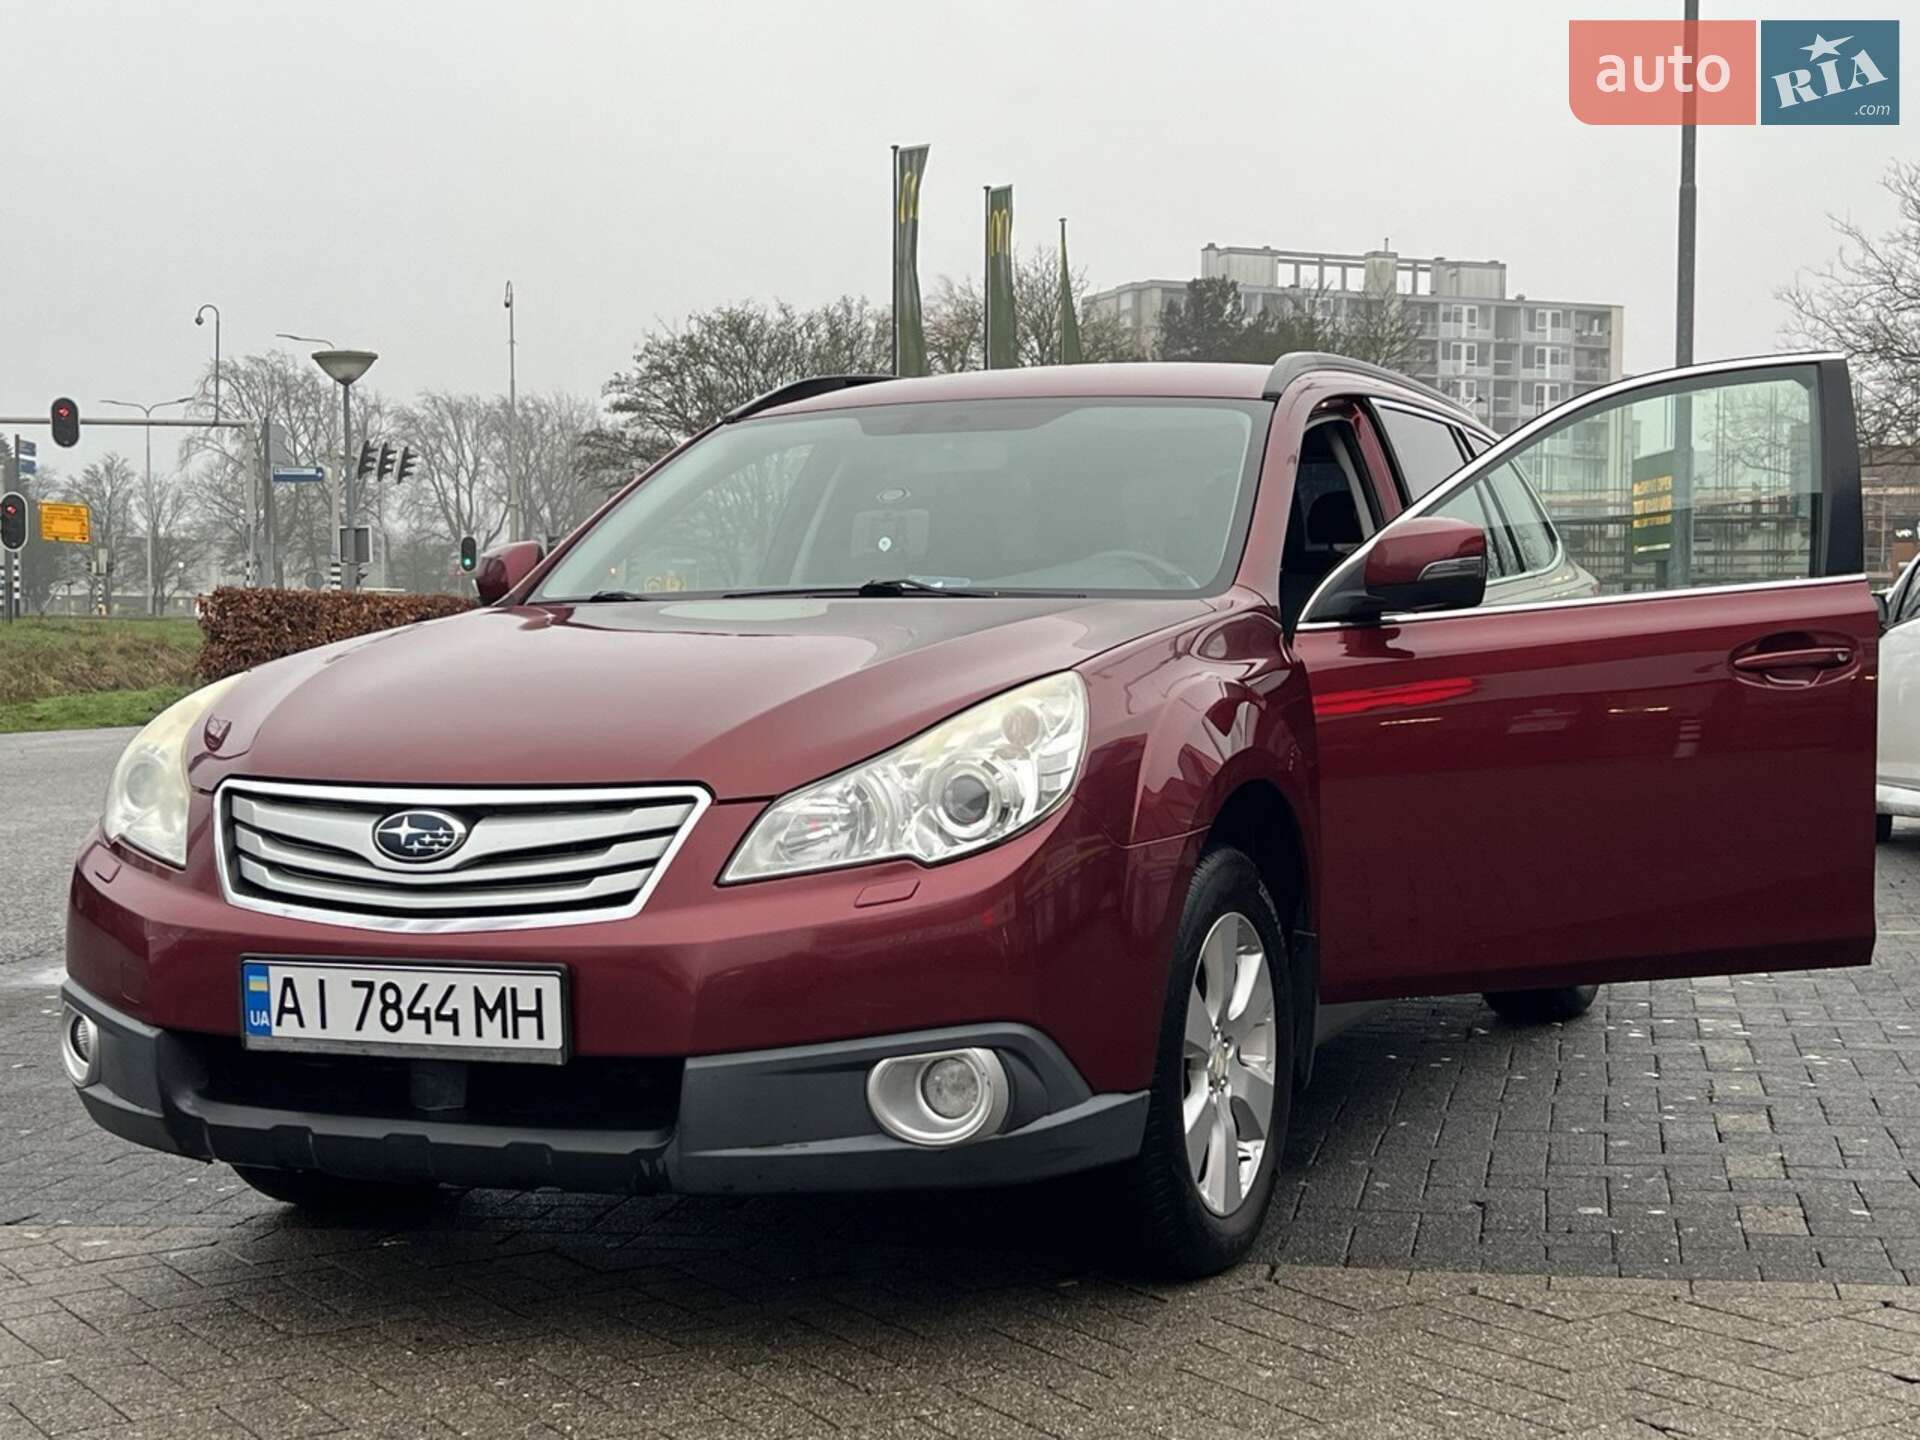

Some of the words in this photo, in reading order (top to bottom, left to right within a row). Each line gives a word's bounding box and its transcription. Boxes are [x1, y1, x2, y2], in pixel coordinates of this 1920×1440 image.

[250, 1009, 271, 1027] UA
[275, 976, 328, 1030] AI
[351, 980, 460, 1037] 7844
[473, 985, 545, 1041] MH
